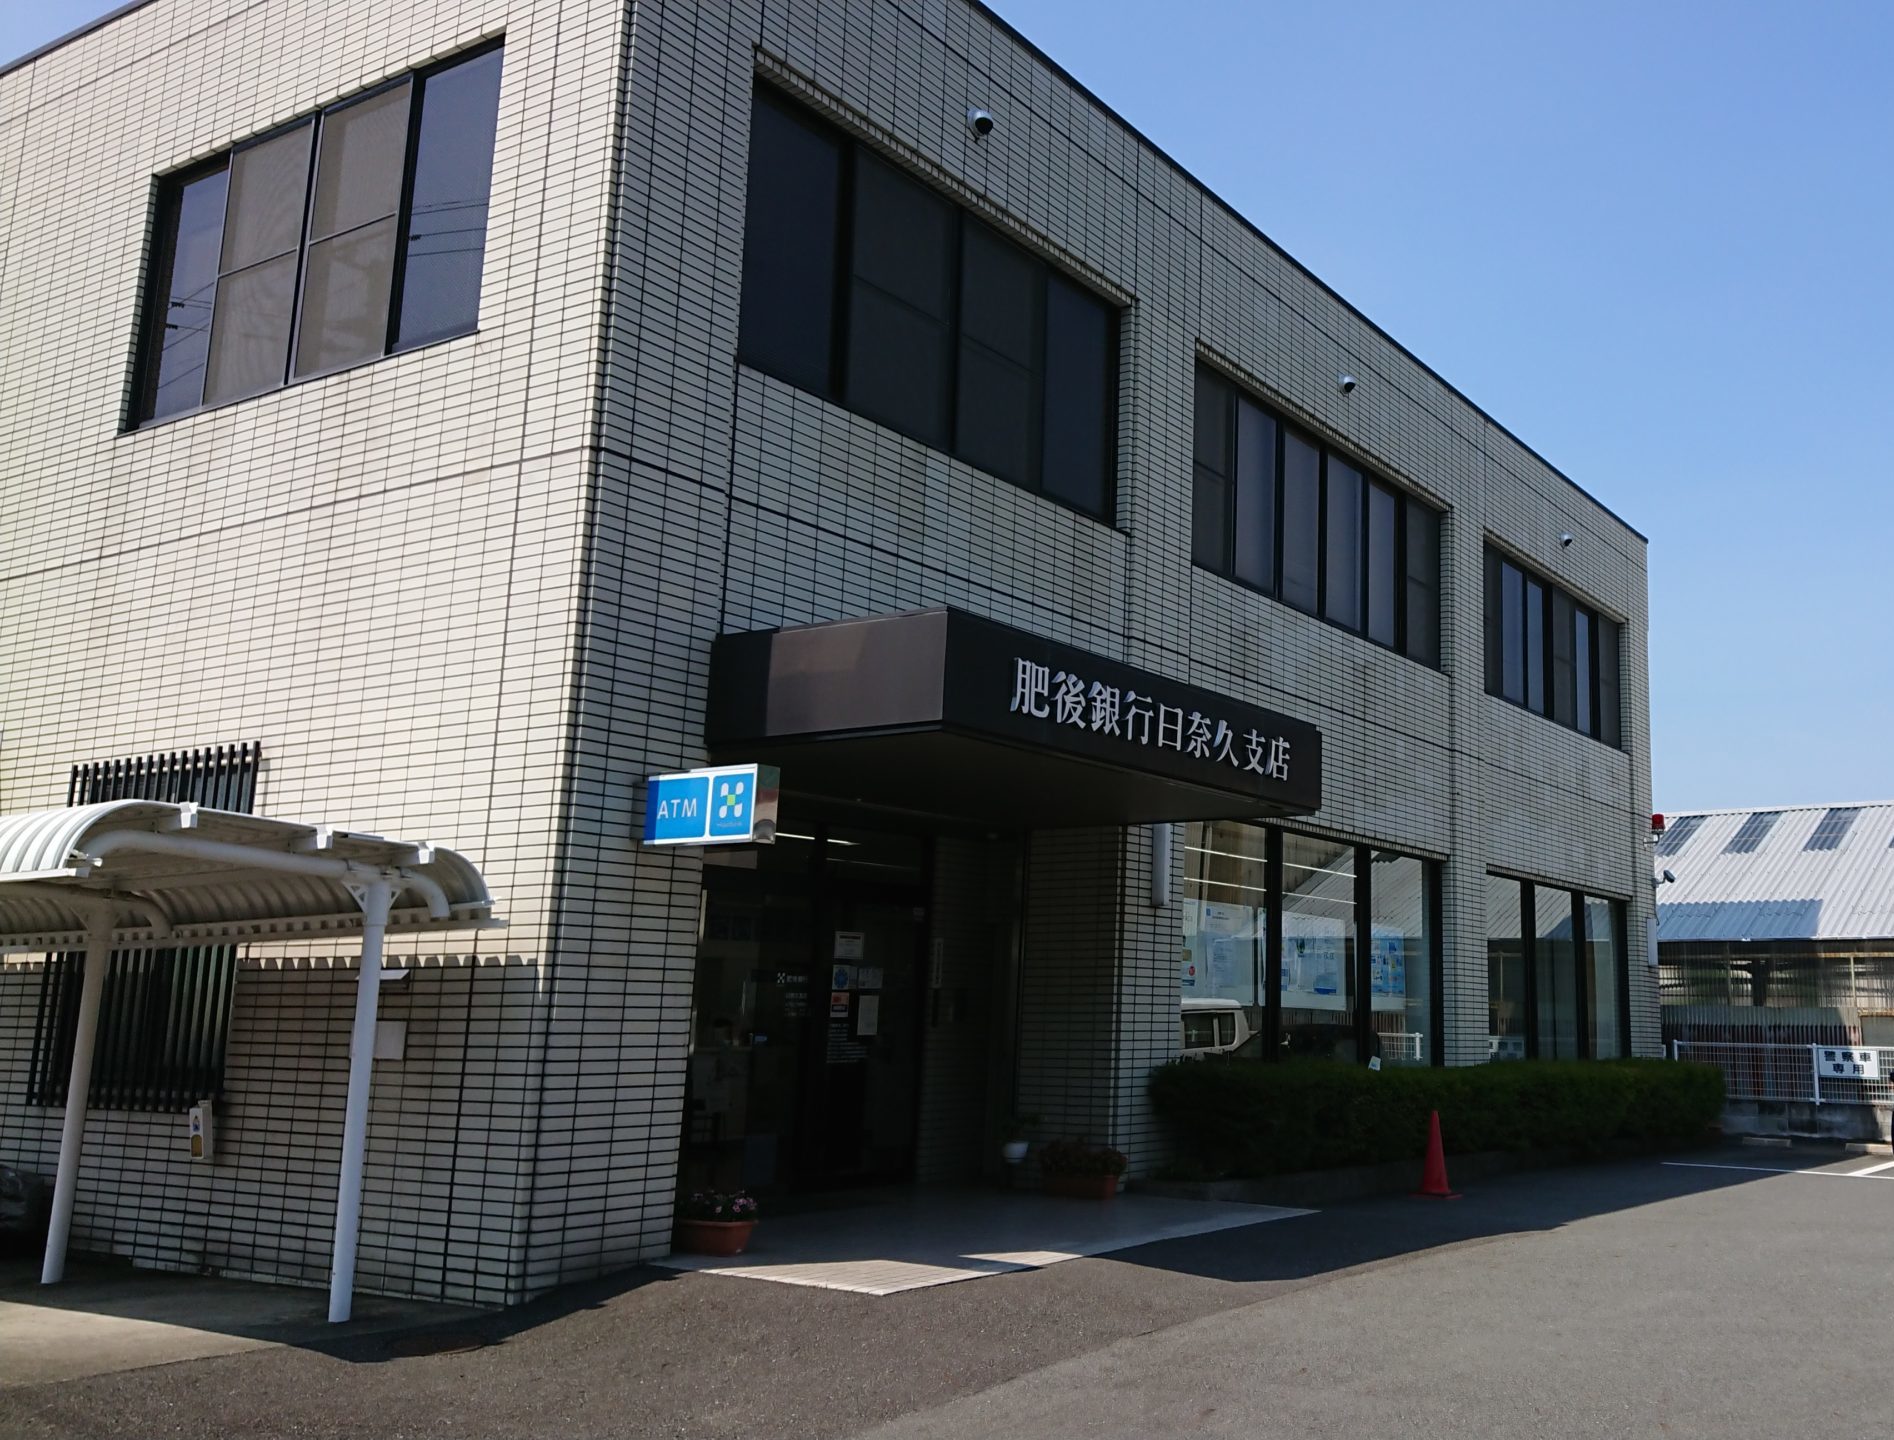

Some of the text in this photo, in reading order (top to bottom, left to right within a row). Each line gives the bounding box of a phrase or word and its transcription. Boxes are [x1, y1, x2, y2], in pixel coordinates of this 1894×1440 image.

[1010, 656, 1291, 782] 肥後銀行日奈久支店
[657, 797, 697, 820] ATM
[1832, 1063, 1865, 1075] 専用
